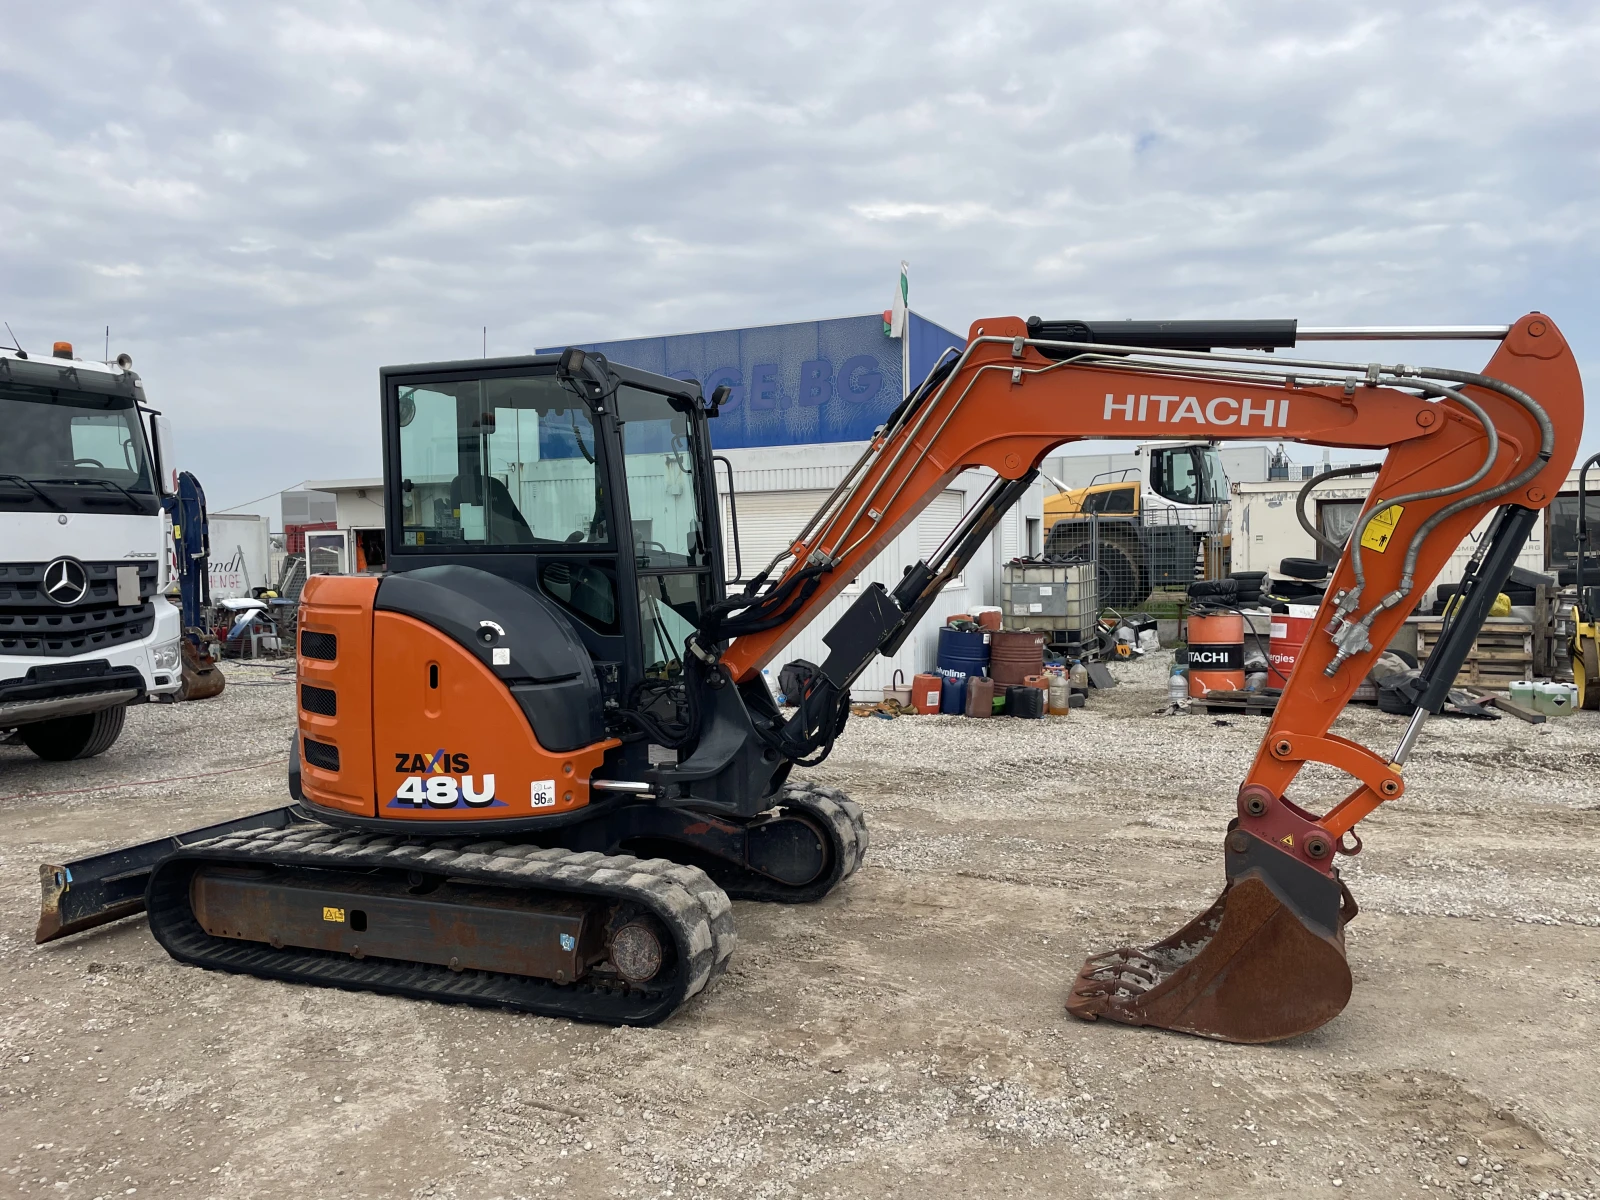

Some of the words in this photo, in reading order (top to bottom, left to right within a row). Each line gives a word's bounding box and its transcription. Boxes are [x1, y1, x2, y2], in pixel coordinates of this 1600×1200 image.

[1103, 394, 1289, 427] HITACHI
[395, 749, 470, 773] ZAXIS
[396, 774, 496, 808] 48U
[534, 792, 547, 805] 96
